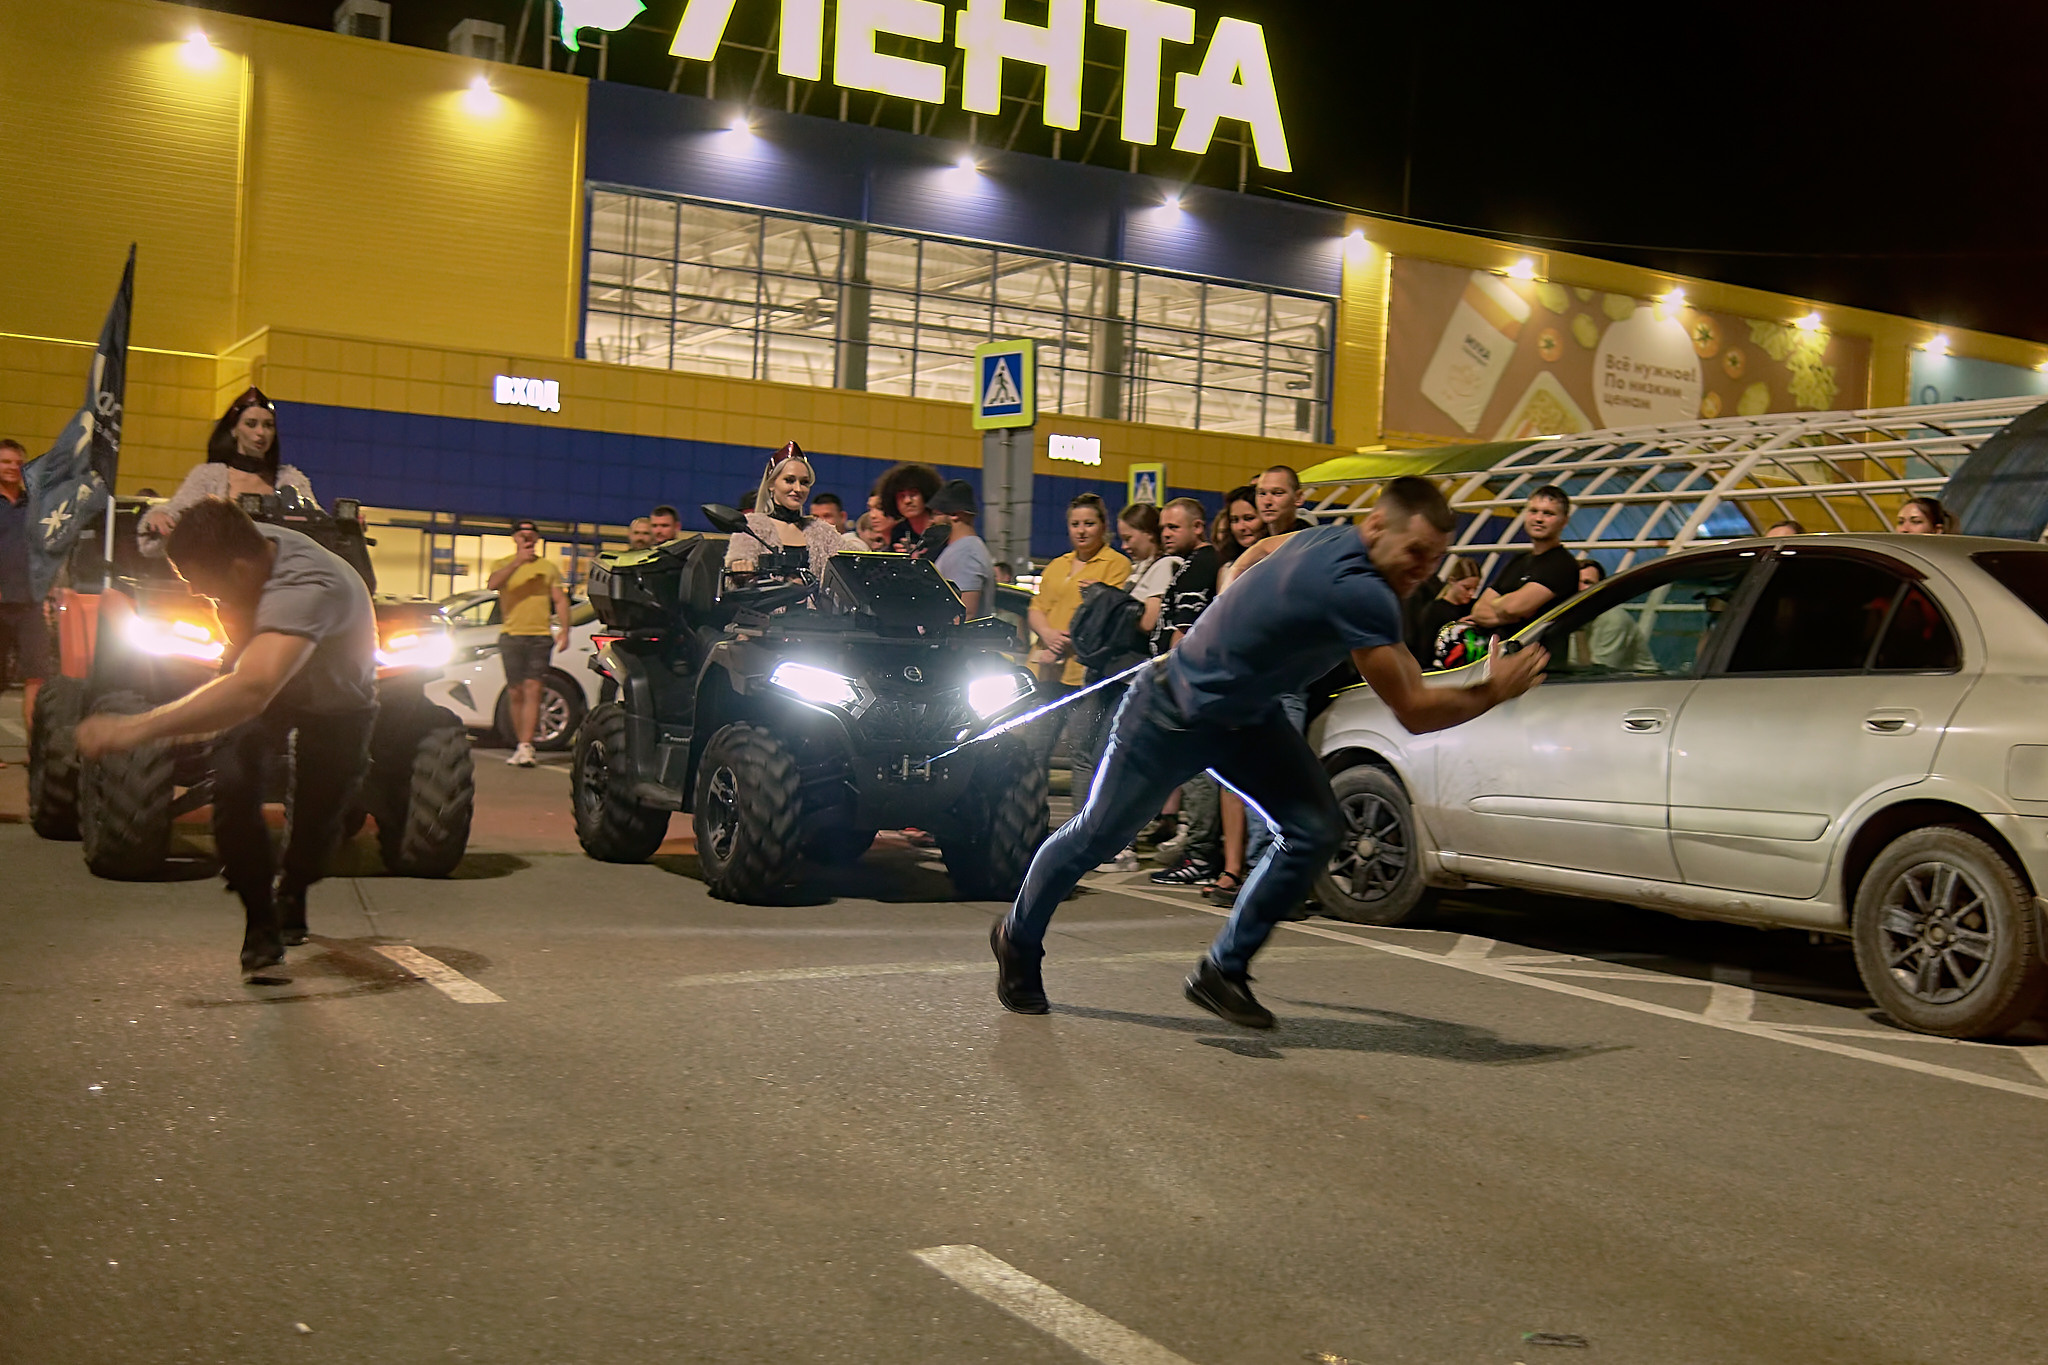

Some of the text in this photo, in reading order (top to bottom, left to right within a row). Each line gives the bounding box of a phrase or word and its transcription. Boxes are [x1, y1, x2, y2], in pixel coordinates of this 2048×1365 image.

[1606, 354, 1696, 381] Всё нужное!
[494, 374, 561, 413] ВХОД
[1604, 372, 1681, 396] По низким
[1603, 394, 1651, 408] ценам
